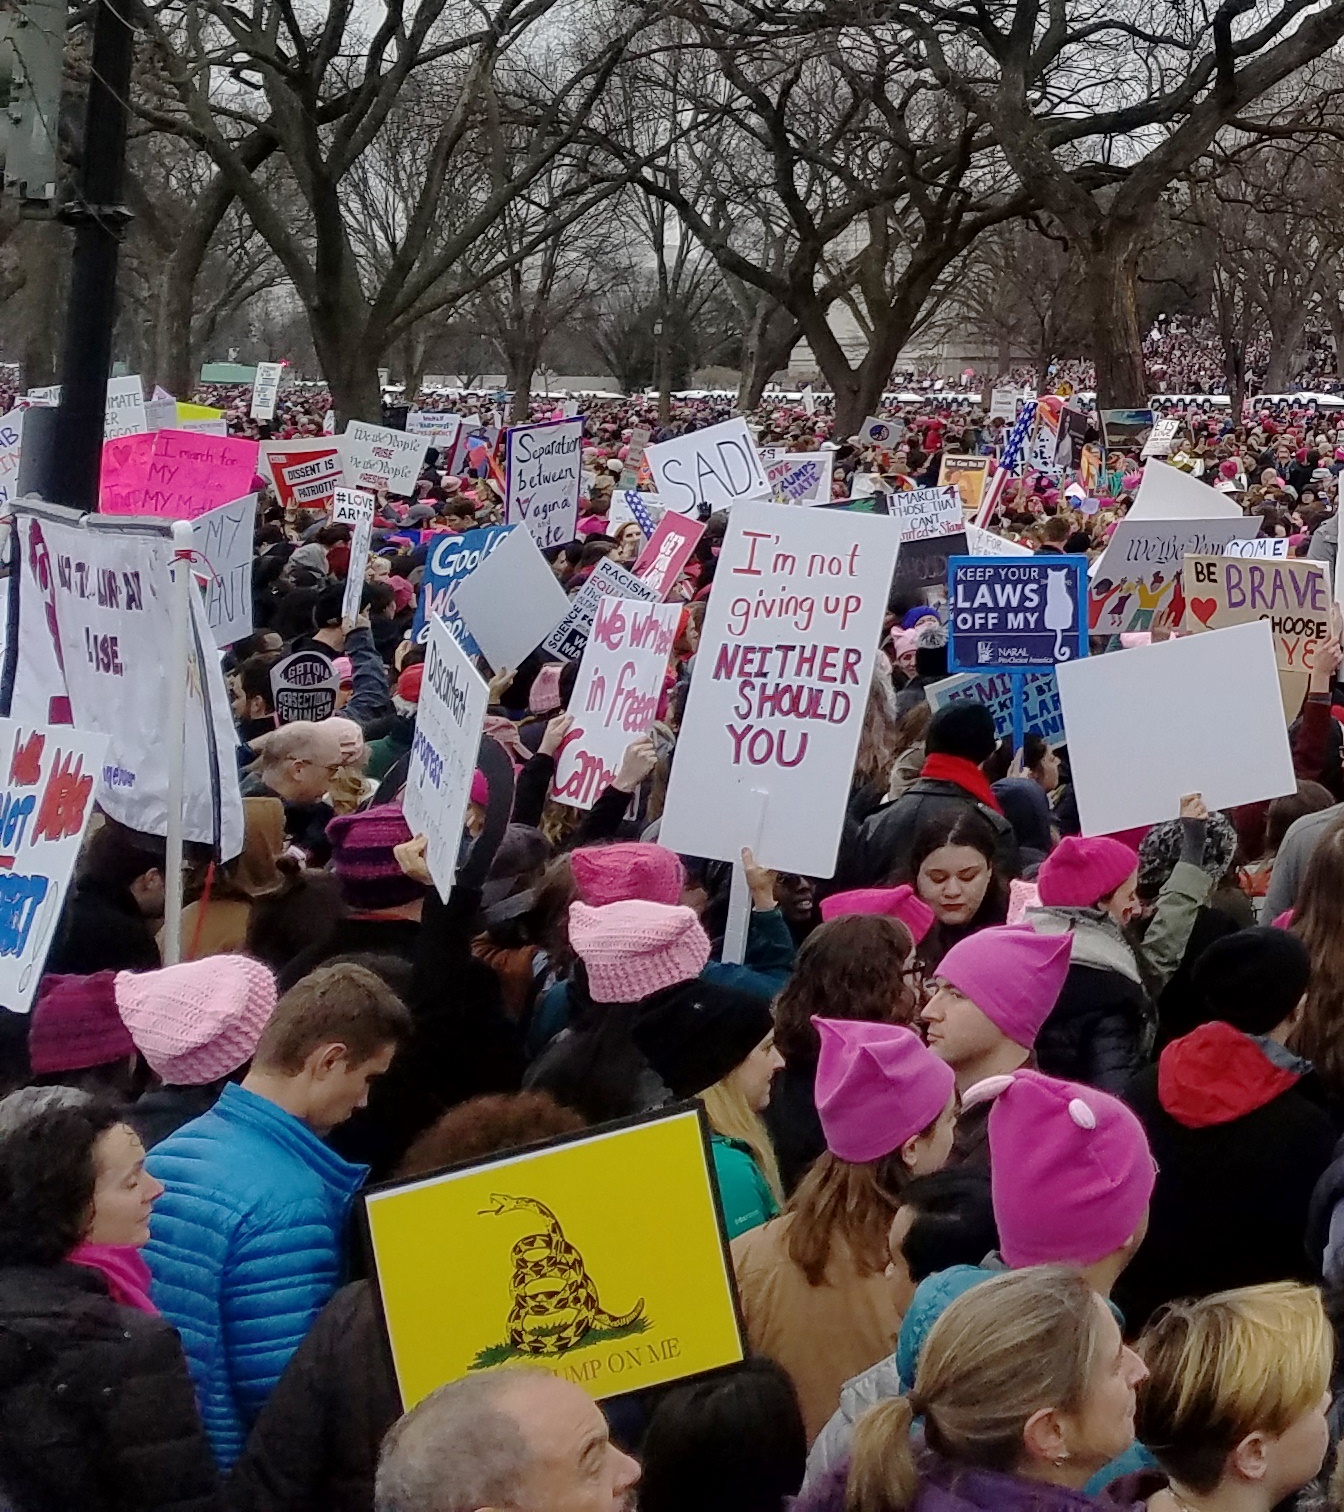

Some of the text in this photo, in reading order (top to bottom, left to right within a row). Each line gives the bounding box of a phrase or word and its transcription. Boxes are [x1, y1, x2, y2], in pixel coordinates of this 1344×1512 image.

[107, 392, 141, 408] IMATE
[515, 433, 582, 464] Separation
[147, 462, 179, 485] MY
[287, 458, 335, 481] DISSENT IS
[517, 465, 575, 492] between
[661, 433, 765, 515] SAD!
[767, 461, 793, 481] OVE
[788, 471, 821, 500] HATE
[898, 489, 941, 508] MARCH
[141, 489, 174, 512] MY
[335, 491, 374, 511] #LOVE
[515, 492, 571, 521] Vagina
[890, 502, 930, 517] THOSE
[531, 523, 564, 549] tate
[731, 529, 795, 577] I'm
[806, 543, 860, 578] not
[956, 567, 994, 581] KEEP
[998, 567, 1039, 580] YOUR
[1194, 561, 1218, 583] BE
[956, 583, 1040, 609] LAWS
[1225, 563, 1328, 612] BRAVE
[726, 584, 814, 637] giving
[822, 594, 863, 631] up
[956, 611, 1040, 630] OFF MY
[547, 604, 583, 650] SCIENCE
[711, 642, 863, 686] NEITHER
[998, 647, 1029, 657] NARAL
[585, 667, 606, 712] in
[1035, 679, 1053, 696] BY
[733, 678, 852, 725] SHOULD
[725, 723, 810, 768] YOU
[553, 1336, 682, 1386] UMP ON ME
